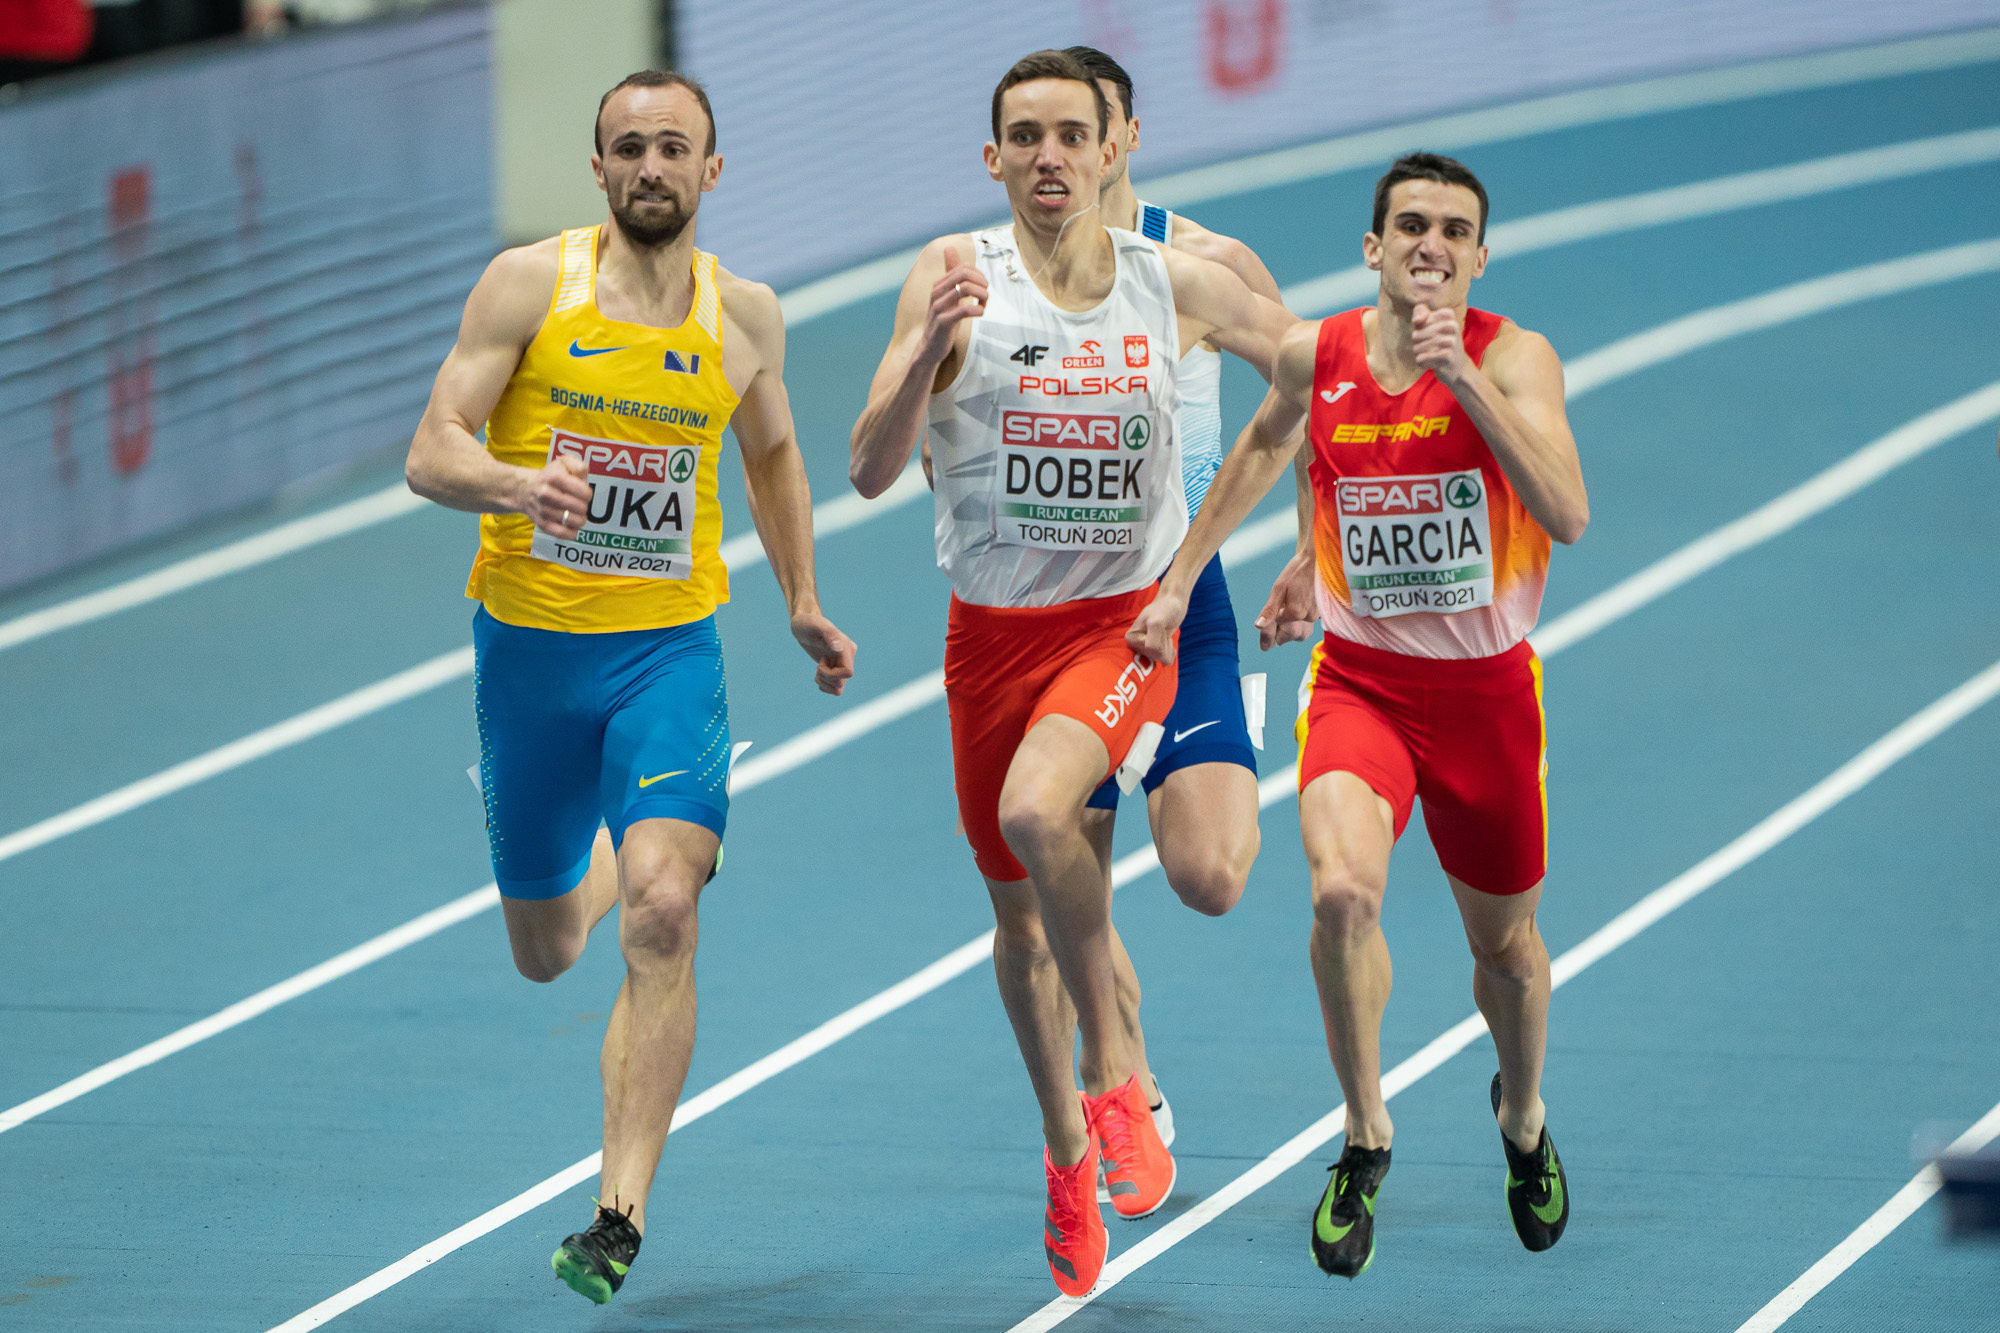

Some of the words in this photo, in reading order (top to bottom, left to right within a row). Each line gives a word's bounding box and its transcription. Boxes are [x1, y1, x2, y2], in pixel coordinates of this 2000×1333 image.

[1010, 344, 1049, 366] 4F
[1063, 357, 1103, 368] ORLEN
[1019, 375, 1147, 396] POLSKA
[551, 387, 708, 429] BOSNIA-HERZEGOVINA
[1005, 415, 1117, 445] SPAR
[1331, 415, 1451, 443] ESPAÑA
[556, 439, 665, 478] SPAR
[1006, 453, 1145, 500] DOBEK
[587, 483, 683, 532] UKA
[1340, 484, 1440, 512] SPAR
[1037, 507, 1068, 520] RUN
[1072, 508, 1119, 522] CLEAN
[576, 530, 608, 546] RUN
[611, 535, 657, 551] CLEAN
[1018, 524, 1086, 544] TORUŃ
[1092, 528, 1132, 544] 2021
[1347, 517, 1483, 566] GARCIA
[554, 543, 624, 569] TORUŃ
[627, 556, 672, 572] 2021
[1373, 575, 1405, 588] RUN
[1433, 587, 1475, 606] 2021
[1094, 653, 1154, 728] OLSKA
